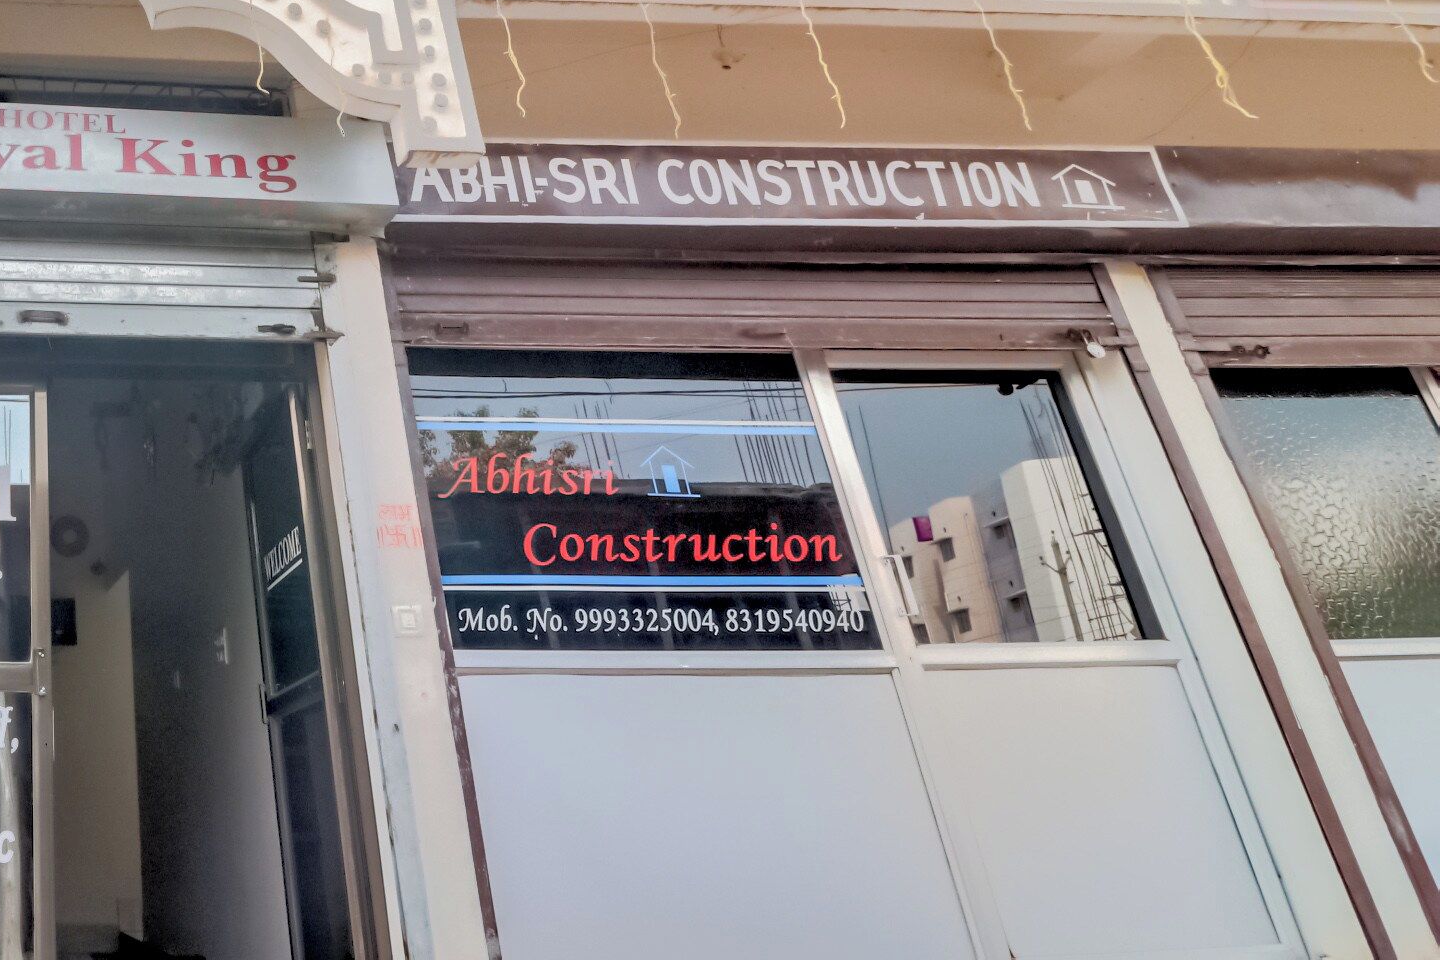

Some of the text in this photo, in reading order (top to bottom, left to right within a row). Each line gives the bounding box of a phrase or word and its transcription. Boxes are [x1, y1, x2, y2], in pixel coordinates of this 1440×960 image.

[113, 137, 299, 193] King
[410, 155, 1041, 209] ABHI-SRI CONSTRUCTION
[437, 452, 620, 499] Abhisri
[263, 526, 302, 581] WELCOME
[523, 522, 843, 566] Construction
[458, 604, 864, 636] Mob. No. 9993325004, 8319540940
